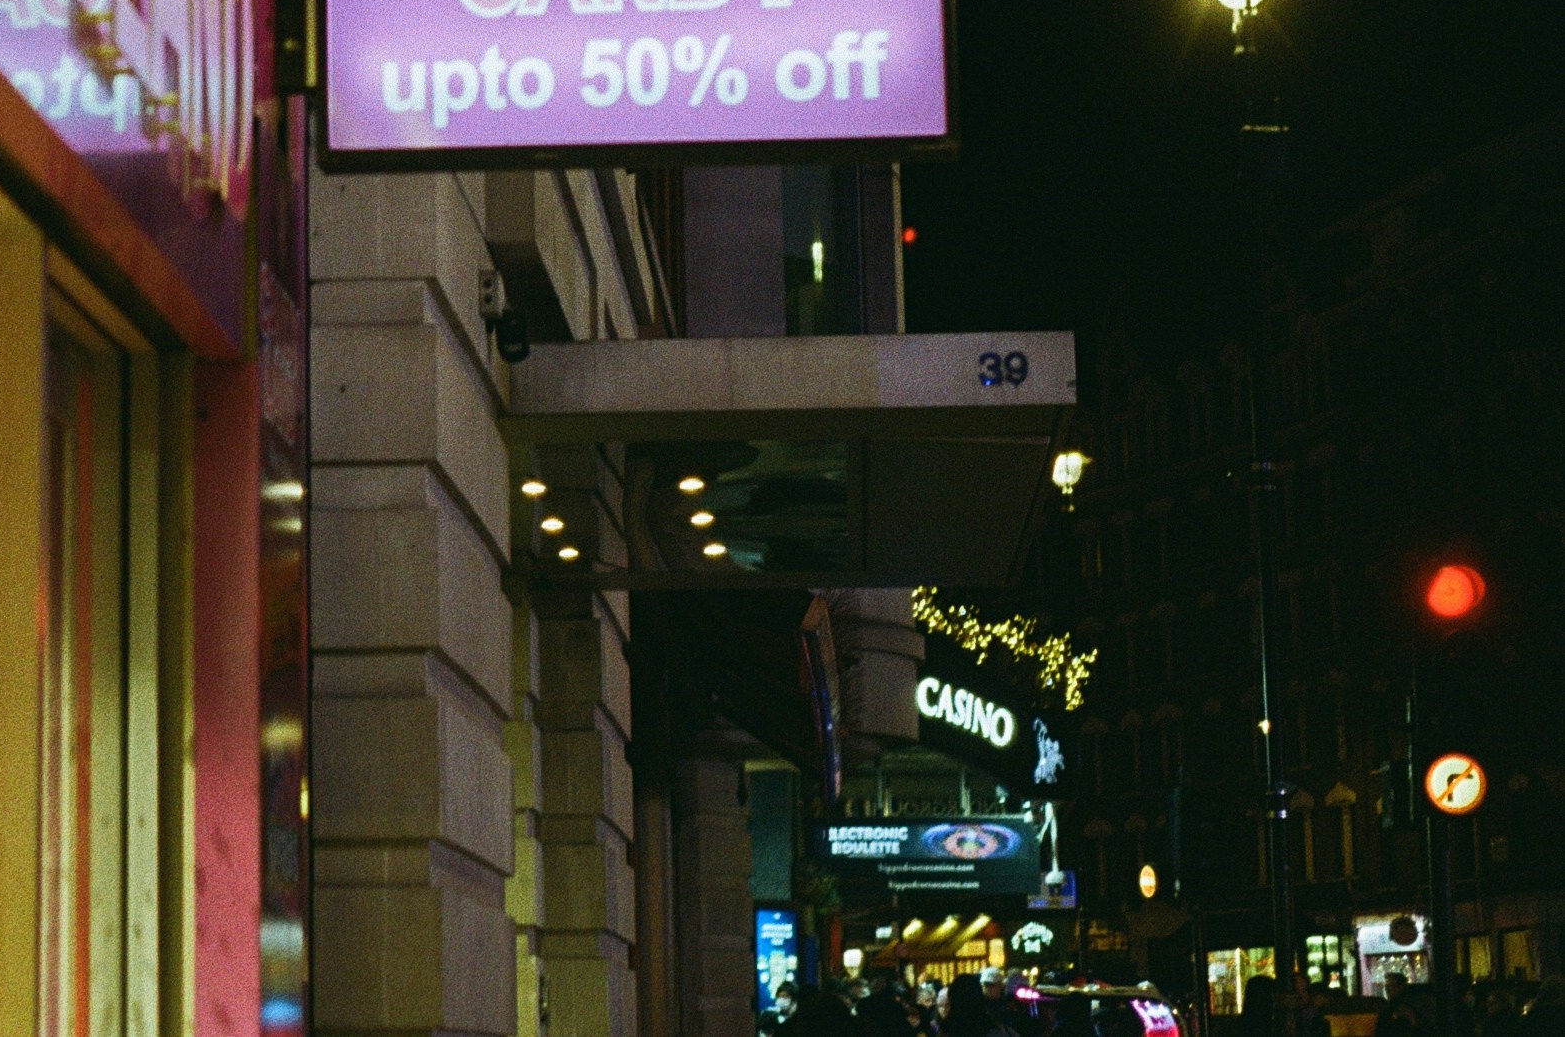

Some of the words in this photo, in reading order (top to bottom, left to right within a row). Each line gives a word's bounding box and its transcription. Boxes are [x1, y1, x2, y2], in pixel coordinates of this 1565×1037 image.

[383, 43, 556, 129] upto
[580, 34, 749, 108] 50%
[775, 29, 890, 102] off
[978, 351, 1029, 386] 39
[916, 677, 1014, 747] CASINO
[831, 842, 900, 855] ROULETTE
